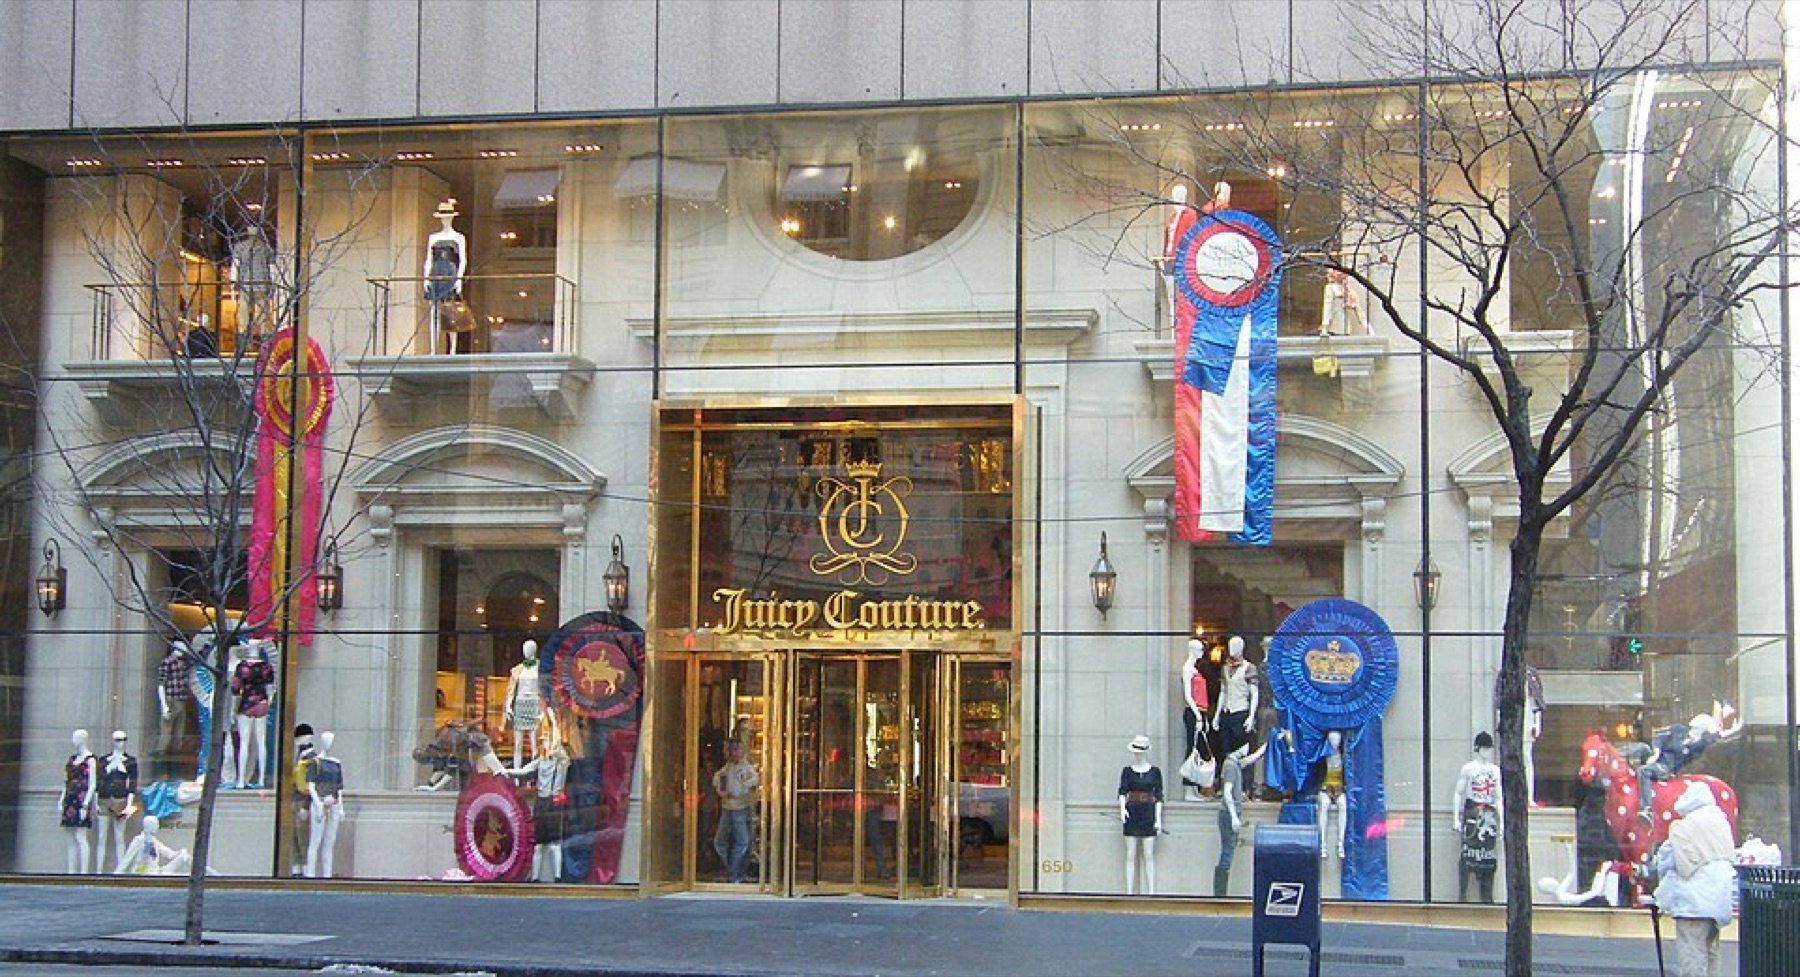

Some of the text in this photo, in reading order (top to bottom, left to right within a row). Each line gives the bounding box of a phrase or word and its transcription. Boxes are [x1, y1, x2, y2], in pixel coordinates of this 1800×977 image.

[712, 589, 981, 636] Juicy Couture
[1042, 860, 1073, 873] 650
